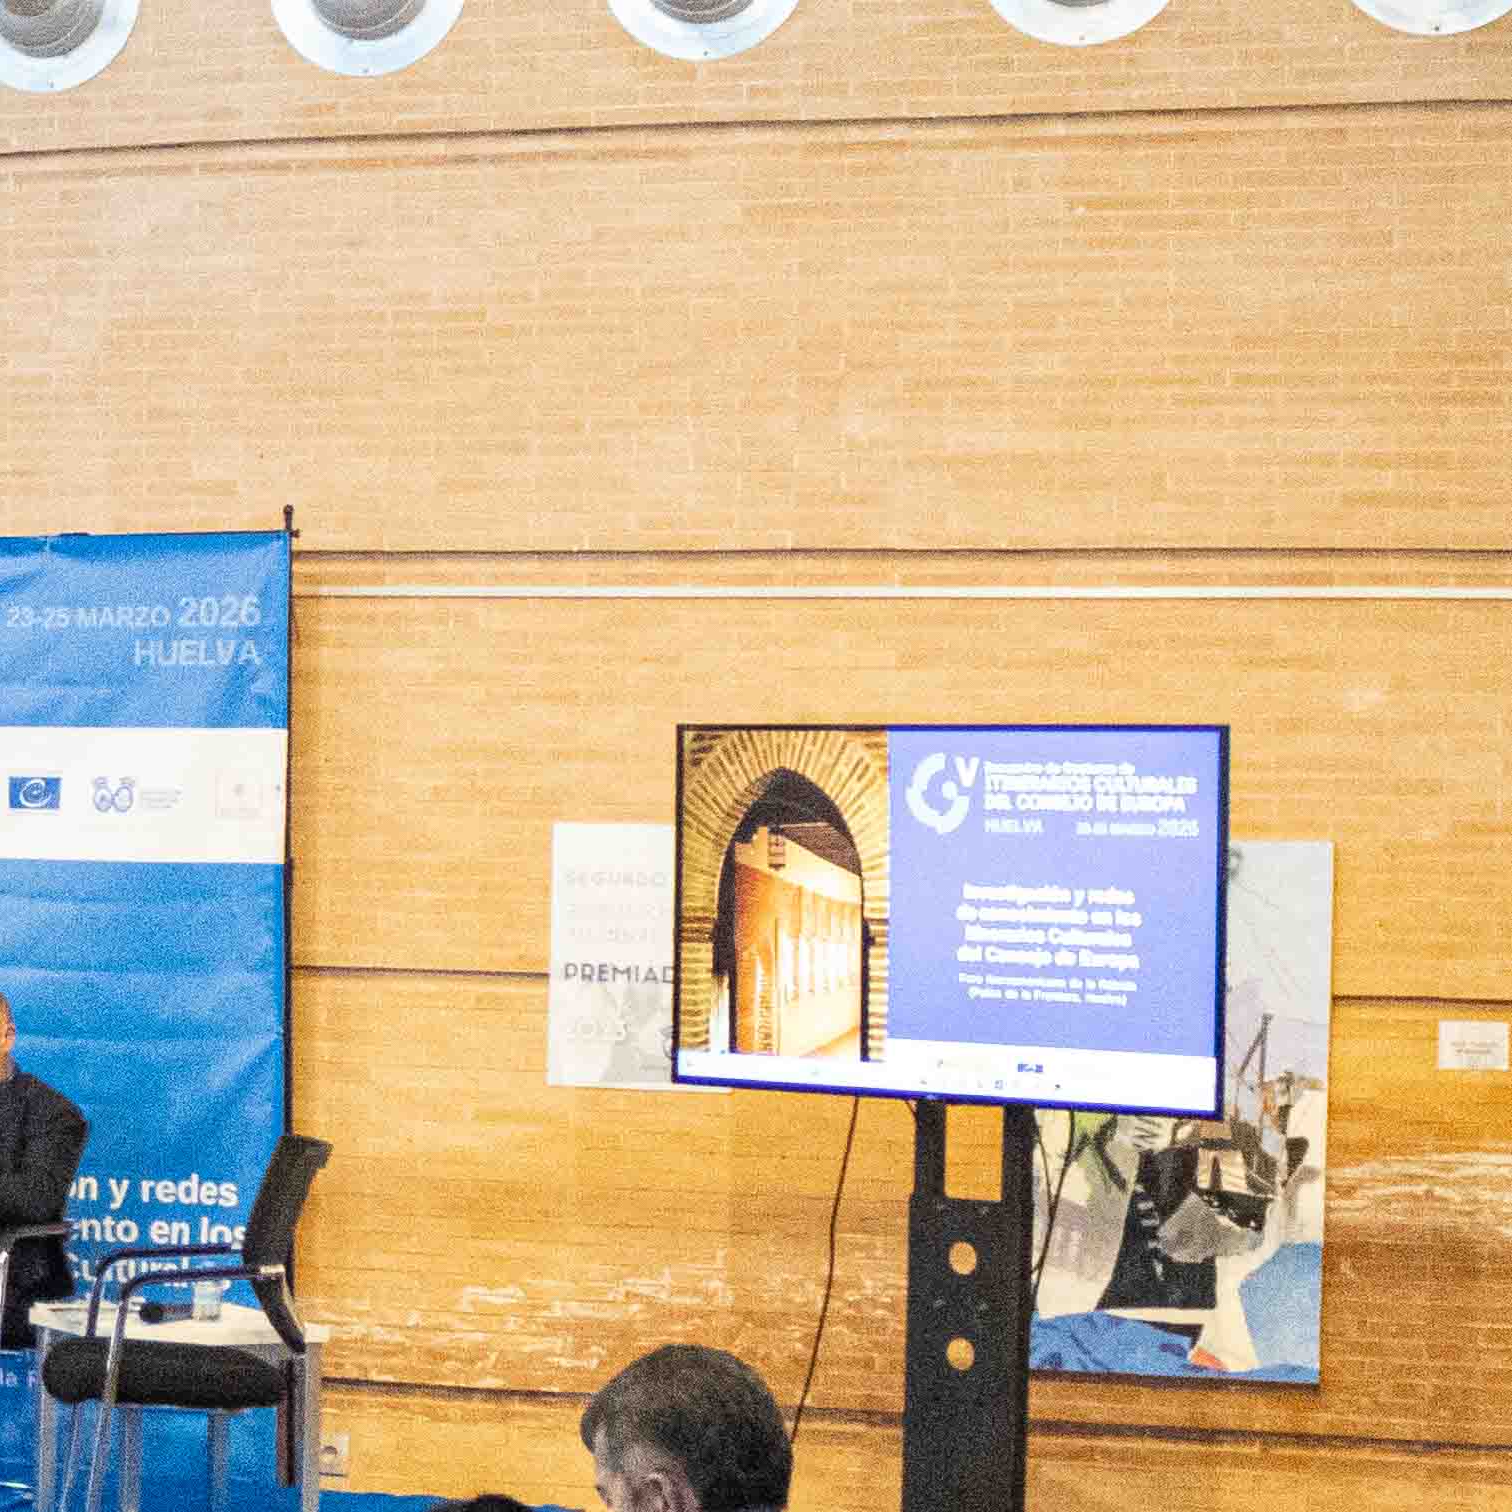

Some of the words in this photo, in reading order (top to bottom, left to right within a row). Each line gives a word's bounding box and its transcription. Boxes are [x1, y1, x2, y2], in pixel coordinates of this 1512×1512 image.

[76, 606, 172, 629] MARZO
[178, 594, 261, 627] 2026
[134, 639, 262, 666] HUELVA
[955, 757, 980, 787] V
[108, 1178, 129, 1210] y
[141, 1173, 239, 1207] redes
[150, 1220, 190, 1245] en
[200, 1216, 246, 1250] los
